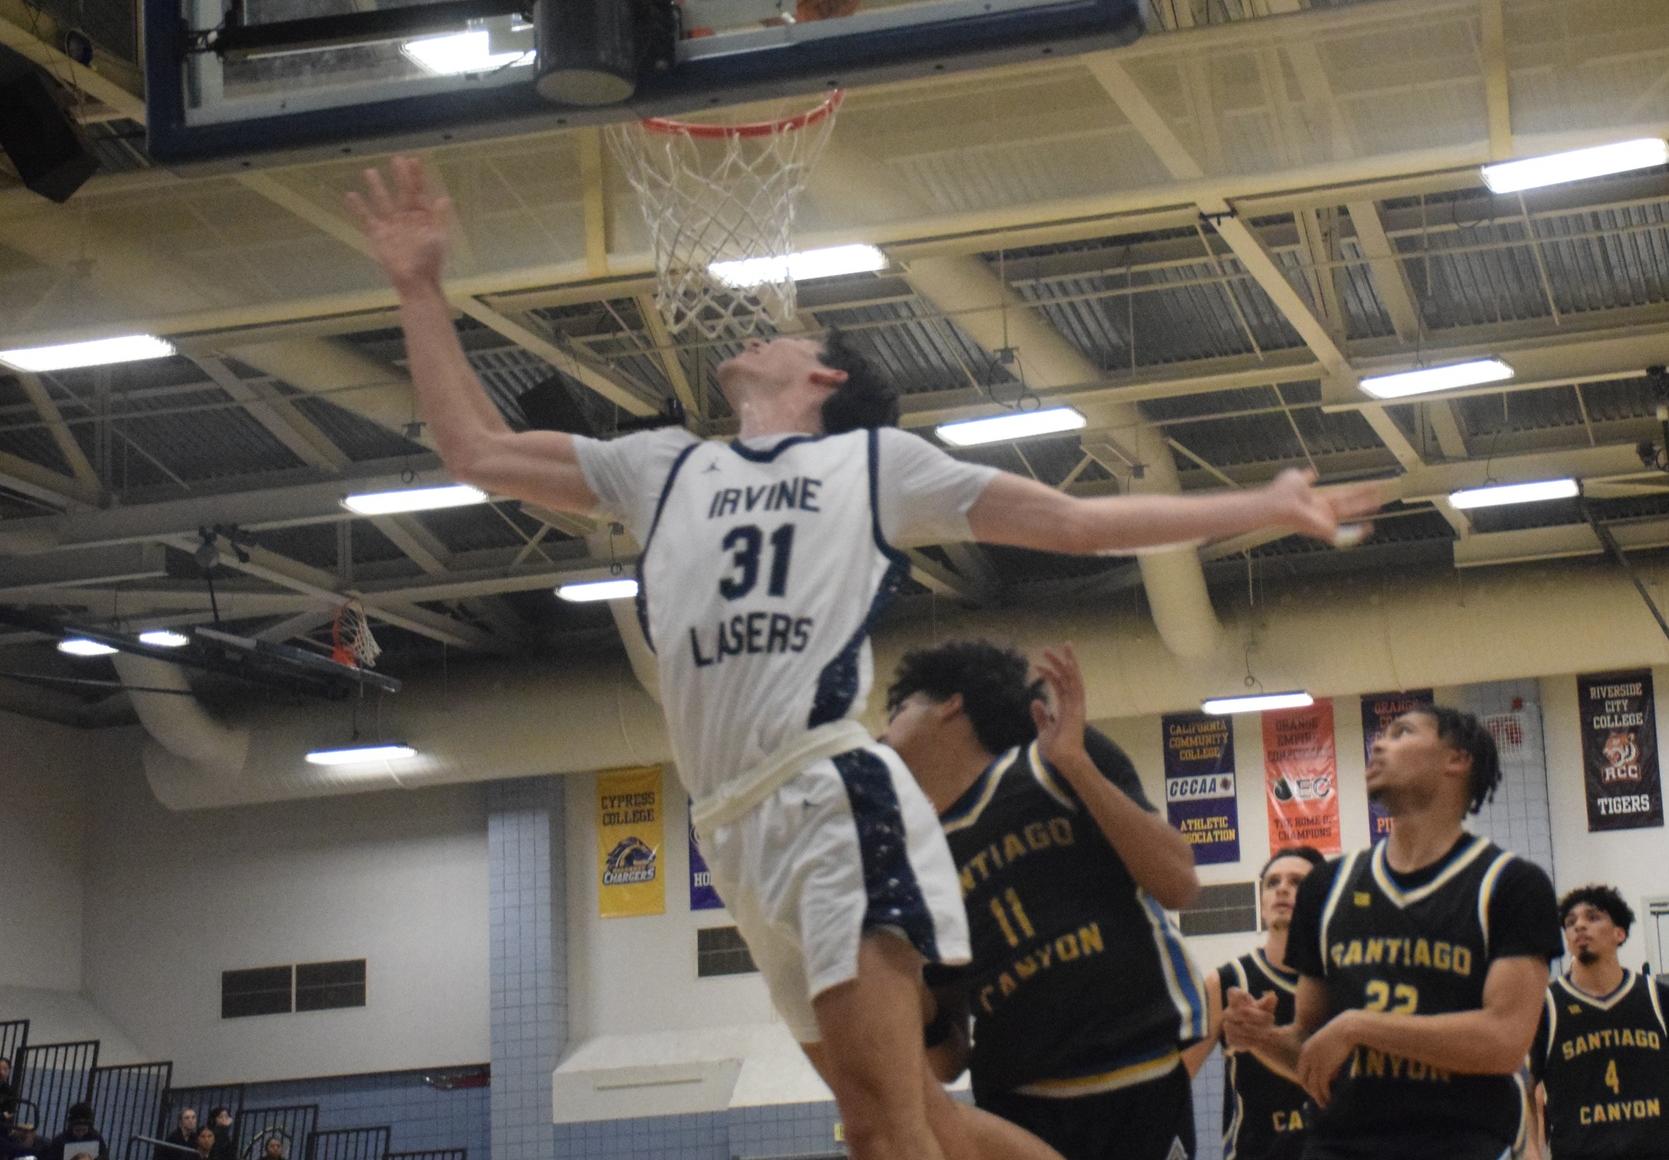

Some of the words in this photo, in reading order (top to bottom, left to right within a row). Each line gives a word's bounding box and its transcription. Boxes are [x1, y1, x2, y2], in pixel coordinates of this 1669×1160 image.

[707, 476, 823, 519] IRVINE
[718, 522, 796, 602] 31
[690, 611, 814, 668] LASERS
[1589, 682, 1643, 699] RIVERSIDE
[1605, 699, 1629, 712] CITY
[1169, 719, 1228, 735] CALIFORNIA
[1593, 712, 1644, 729] COLLEGE
[1169, 732, 1229, 749] COMMUNITY
[1179, 747, 1221, 760] COLLEGE
[1605, 764, 1639, 781] RCC
[1169, 778, 1217, 797] CCCAA
[601, 791, 656, 810] CYPRESS
[1597, 794, 1650, 815] TIGERS
[602, 808, 655, 826] COLLEGE
[1180, 816, 1229, 833] ATHLETIC
[1182, 829, 1236, 844] SOCIATION
[960, 816, 1075, 895] NTIAGO
[603, 865, 656, 885] CHARGERS
[990, 886, 1036, 948] 11
[1330, 937, 1472, 977] SANTIAGO
[1562, 1028, 1661, 1060] SANTIAGO
[1604, 1059, 1620, 1095] 4
[1579, 1097, 1661, 1125] CANYON
